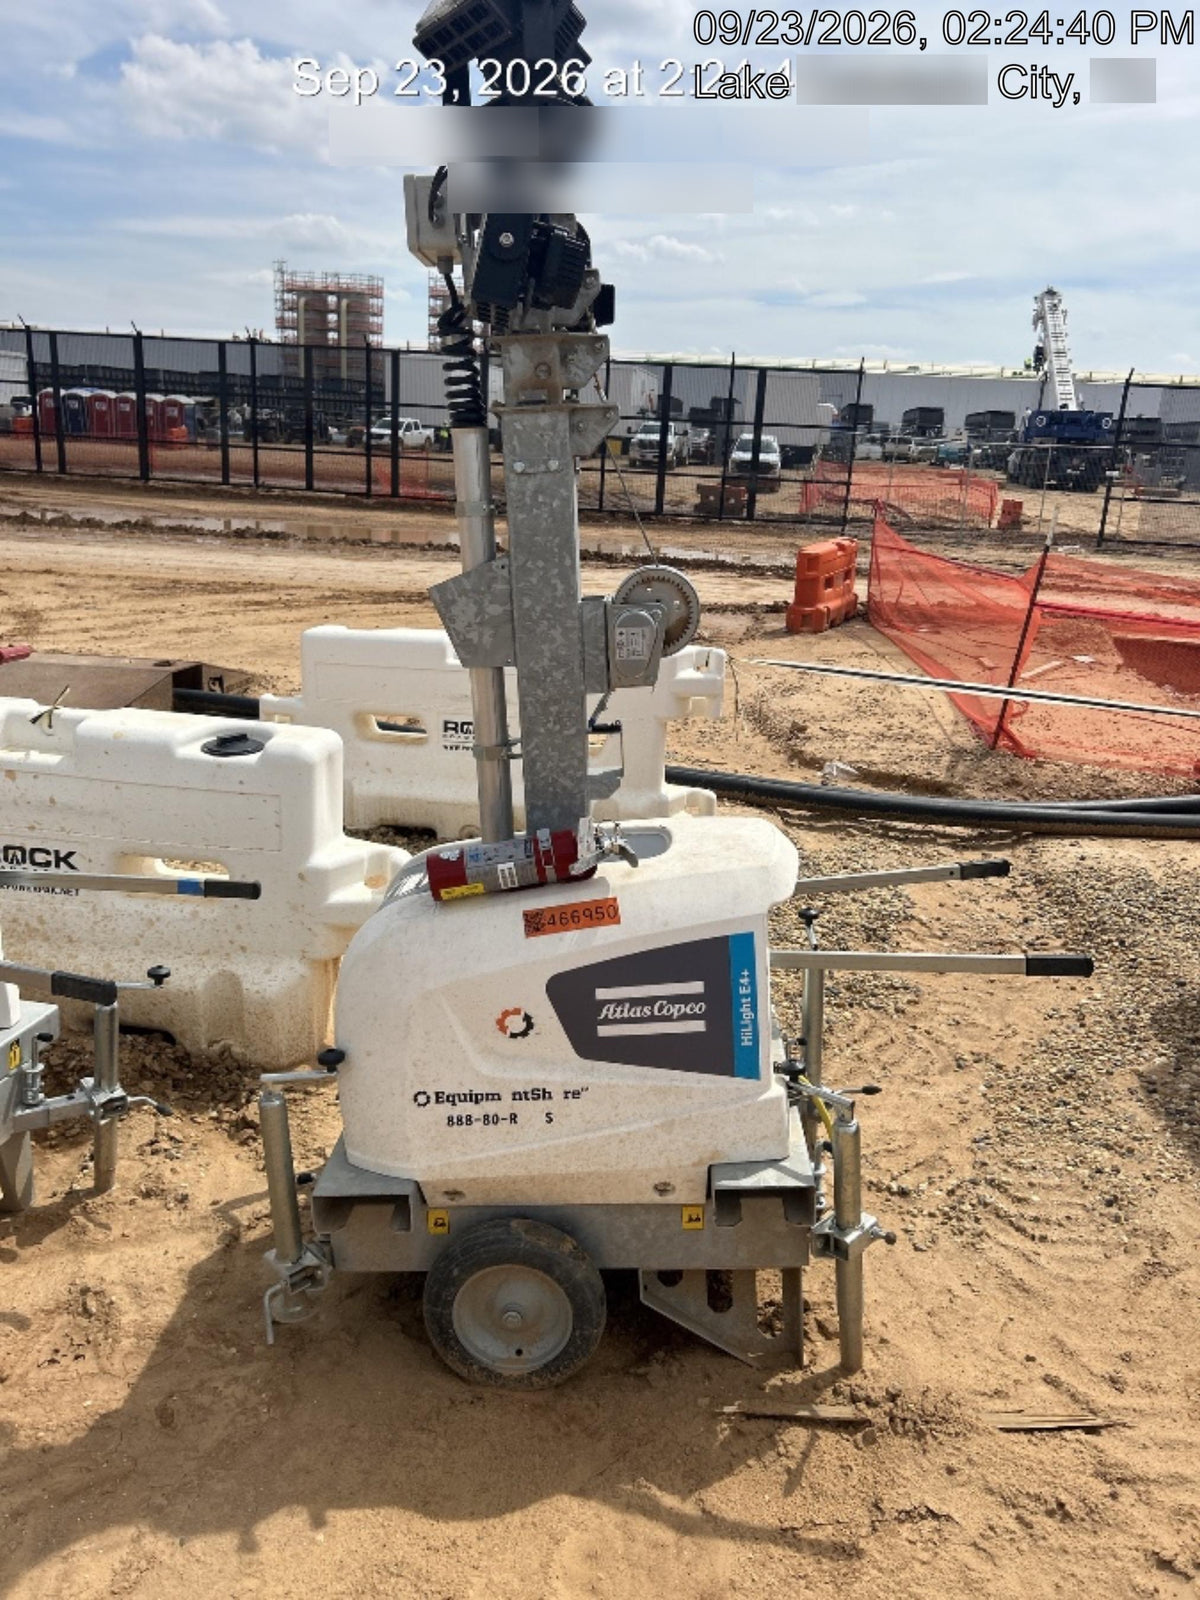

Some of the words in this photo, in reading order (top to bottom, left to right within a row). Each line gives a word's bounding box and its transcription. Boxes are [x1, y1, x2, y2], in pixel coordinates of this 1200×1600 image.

[0, 844, 79, 872] OCK
[546, 903, 619, 926] 466950
[738, 968, 751, 995] E4+
[597, 1001, 652, 1020] Atlas
[653, 999, 707, 1019] Copco
[740, 997, 755, 1047] HiLight
[434, 1087, 582, 1107] EquipmntShre
